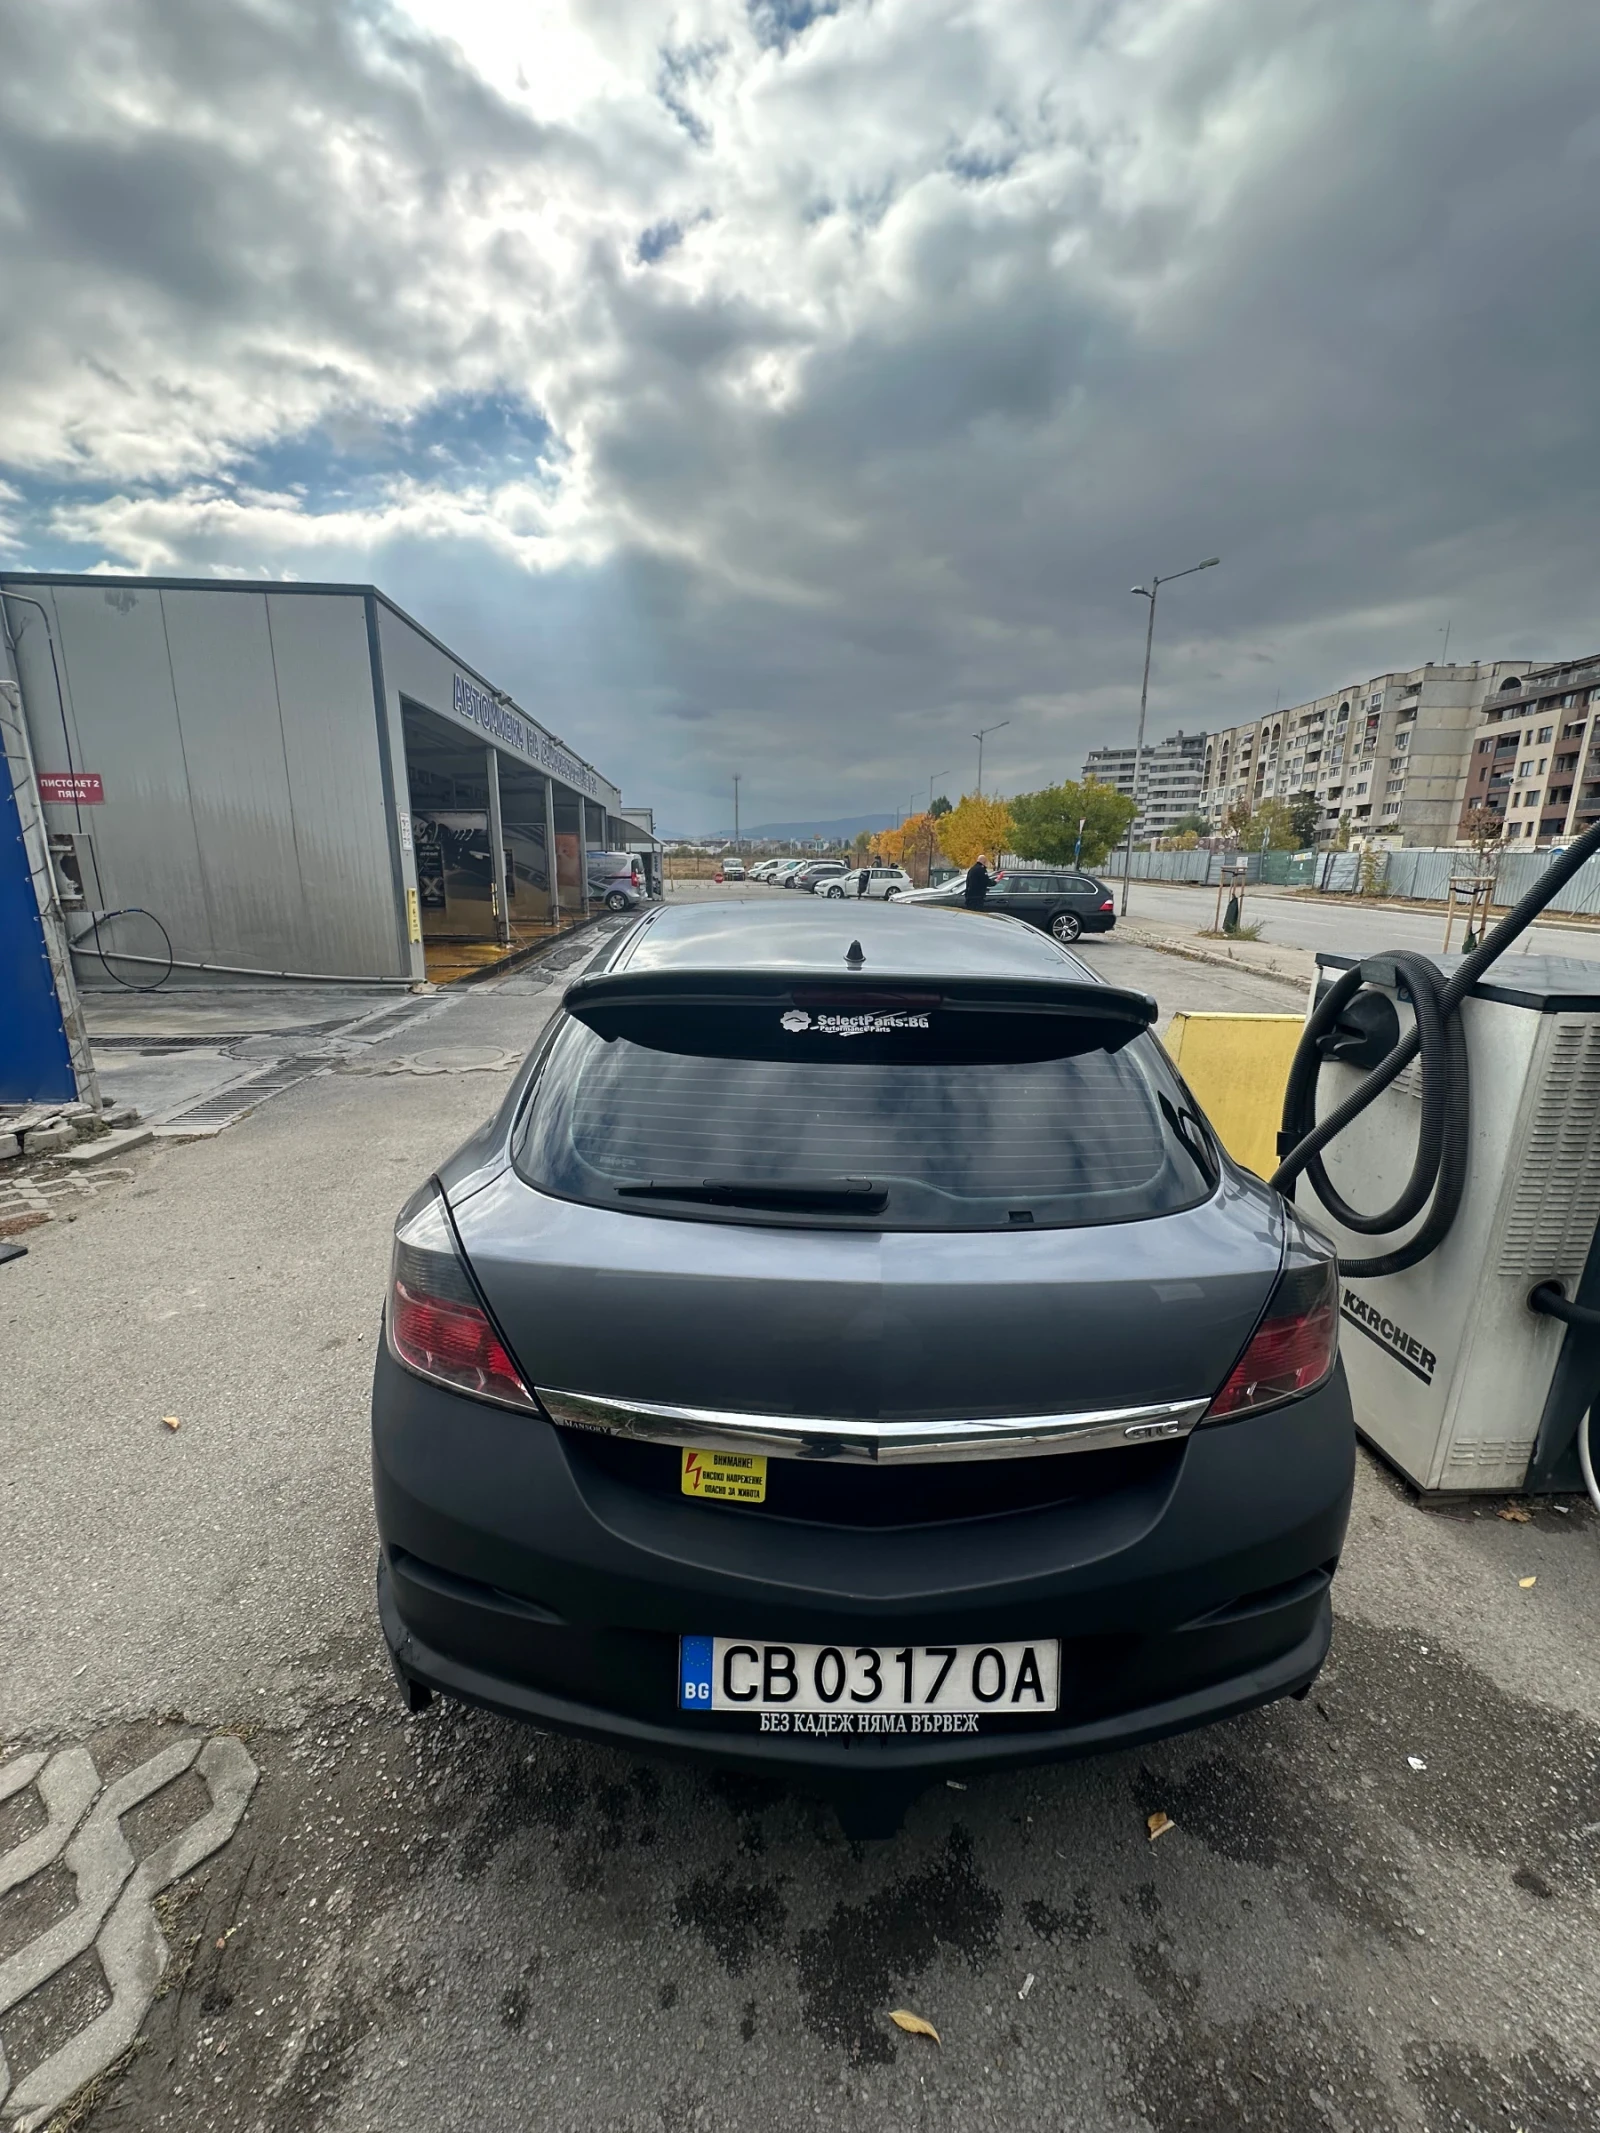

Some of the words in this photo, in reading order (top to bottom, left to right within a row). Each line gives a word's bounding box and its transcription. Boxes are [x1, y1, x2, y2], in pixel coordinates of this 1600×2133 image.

[527, 727, 540, 760] НА
[40, 779, 92, 788] ПИСТОЛЕТ
[93, 780, 100, 788] 2
[817, 1014, 930, 1029] SelectParts.BG
[819, 1024, 869, 1033] Performance
[1343, 1288, 1437, 1375] KÄRCHER
[564, 1419, 608, 1434] MANSORY
[713, 1454, 753, 1469] ВНИМАНИЕ!
[702, 1471, 725, 1482] ВИСОКО
[726, 1473, 763, 1485] НАПРЕЖЕНИЕ
[704, 1484, 727, 1495] ОПАСНО
[728, 1487, 736, 1496] ЗА
[737, 1488, 761, 1499] ЖИВОТА
[722, 1645, 799, 1703] CB
[813, 1646, 958, 1704] 0317
[971, 1646, 1046, 1704] OA
[684, 1682, 710, 1699] BG
[759, 1712, 791, 1732] БЕЗ
[793, 1714, 855, 1737] КАДЕЖ
[857, 1714, 907, 1733] НЯМА
[910, 1714, 980, 1733] ВЪРВЕЖ
